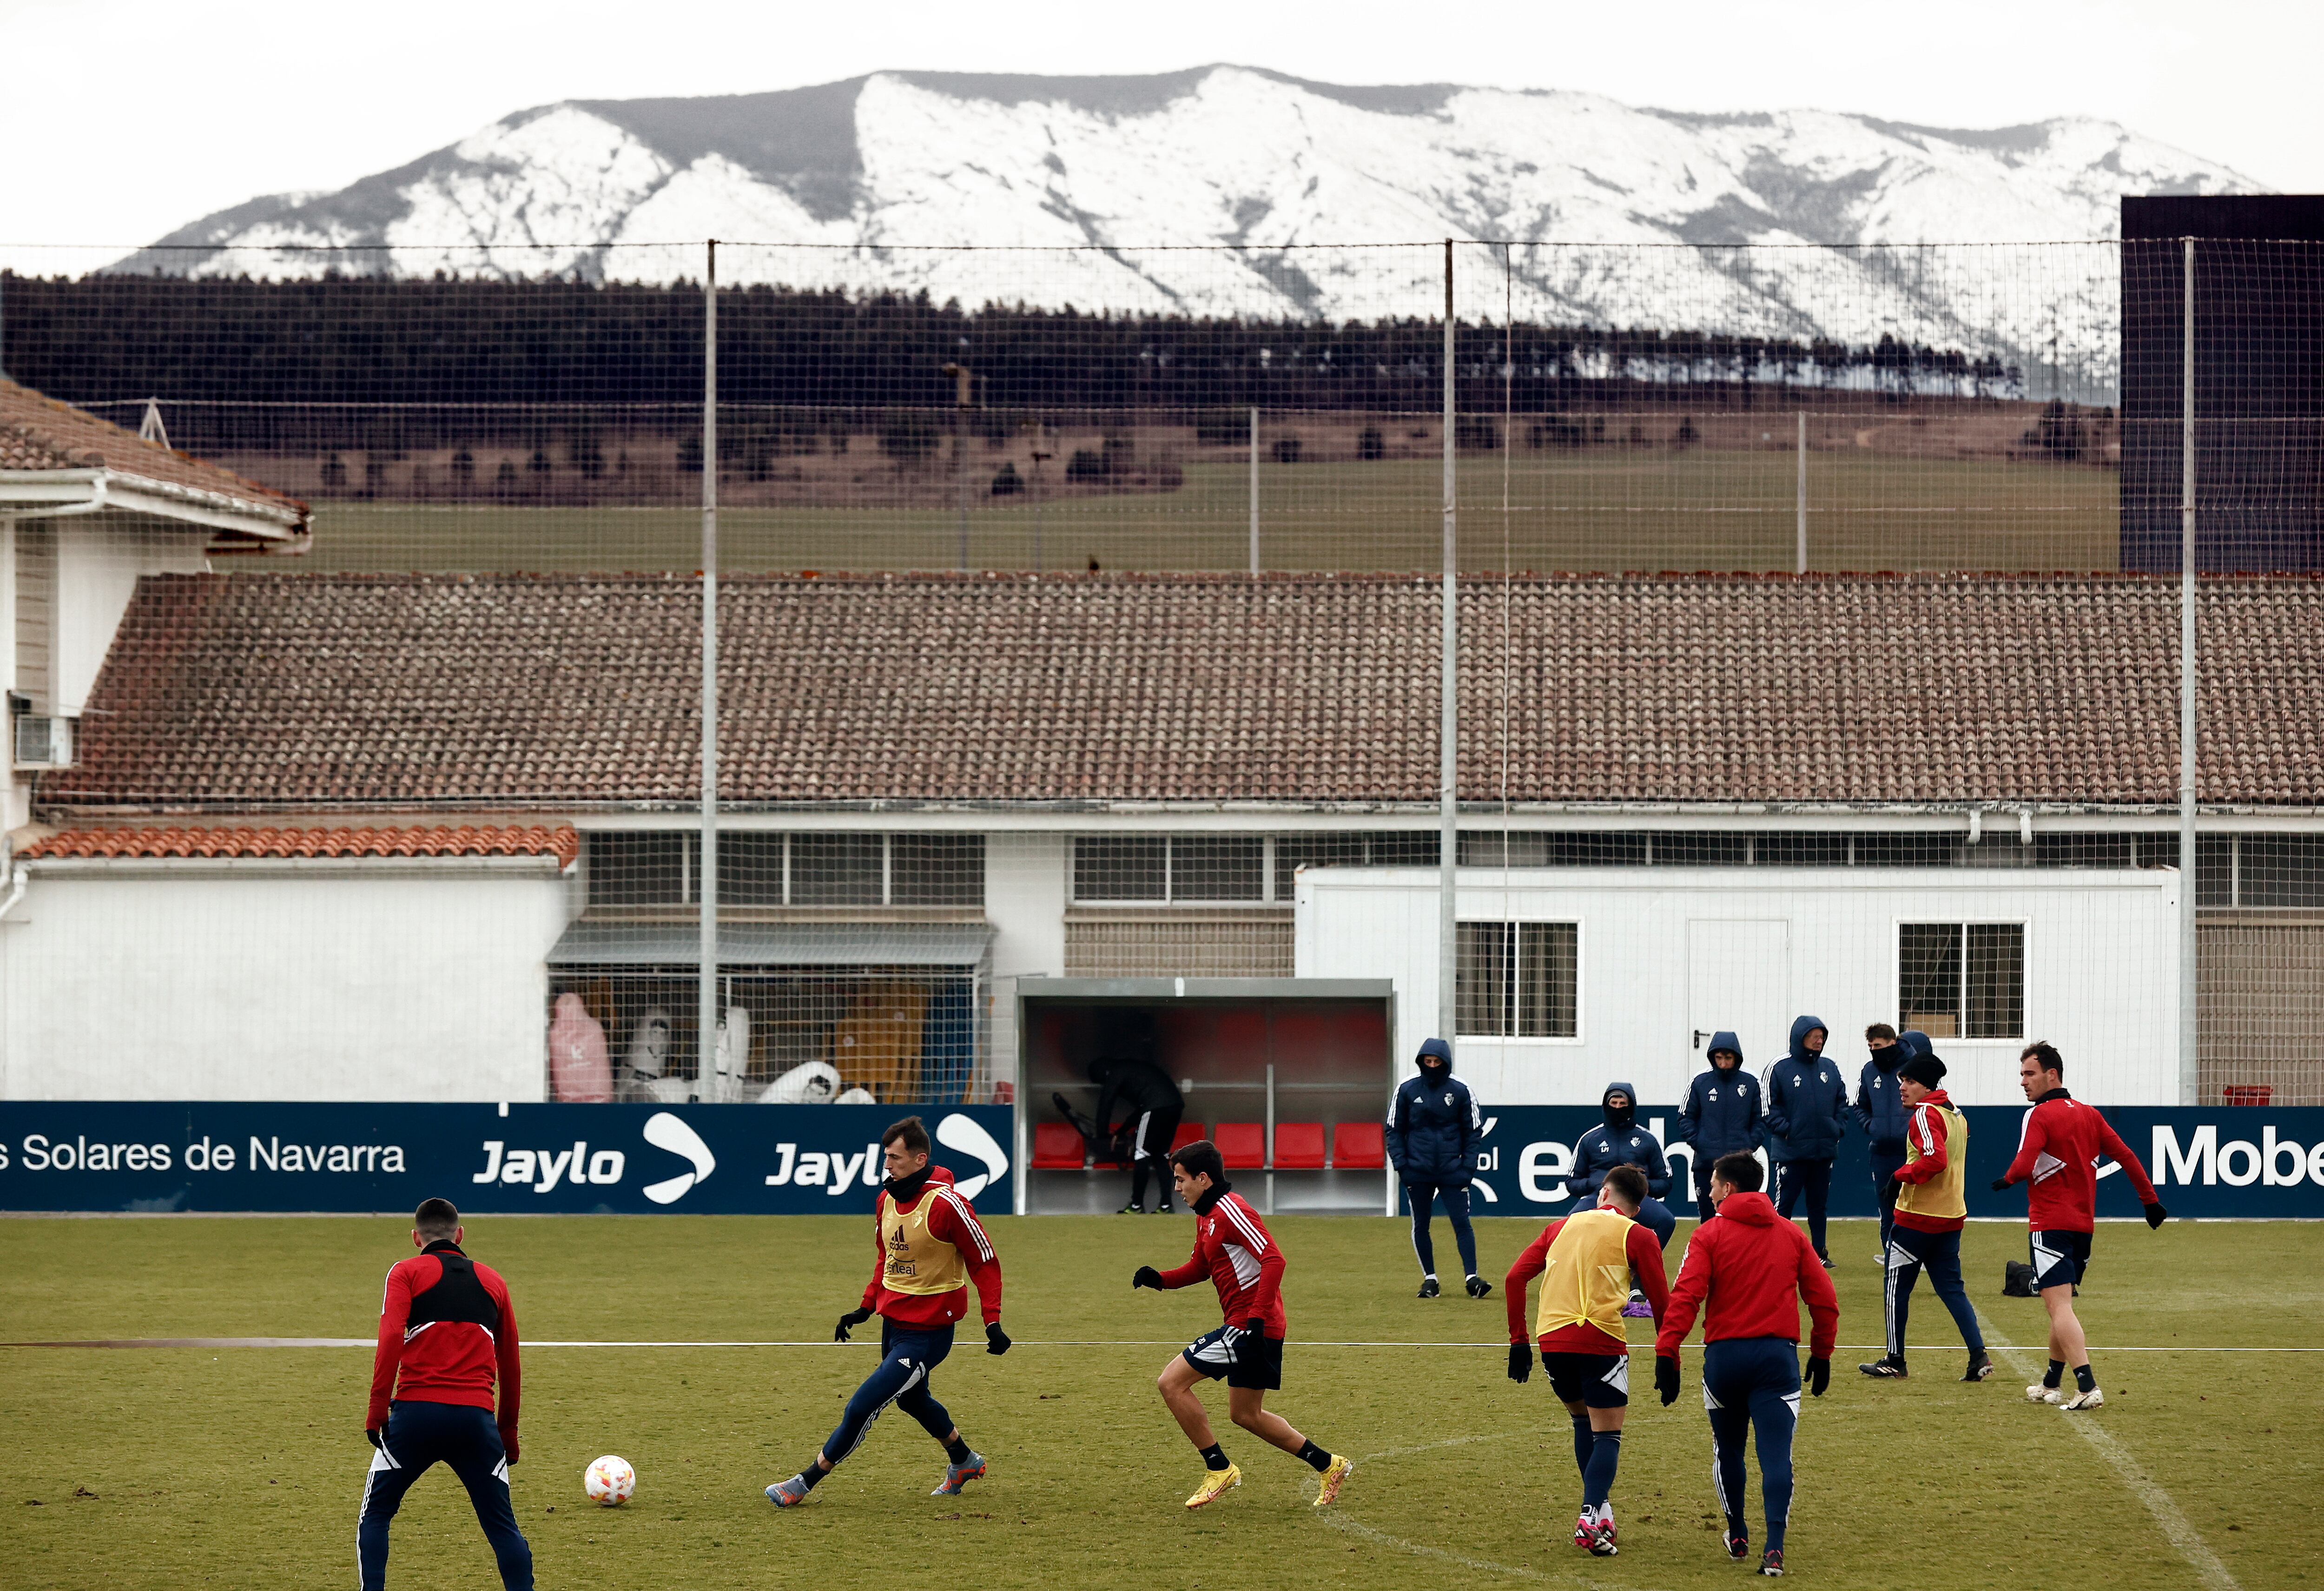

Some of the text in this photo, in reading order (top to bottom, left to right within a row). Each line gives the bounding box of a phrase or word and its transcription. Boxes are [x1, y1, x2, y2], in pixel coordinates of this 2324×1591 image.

[23, 1135, 172, 1170] Solares
[185, 1136, 235, 1171] de
[250, 1136, 405, 1172] Navarra
[472, 1141, 625, 1193] Jaylo
[765, 1144, 888, 1196] Jayl
